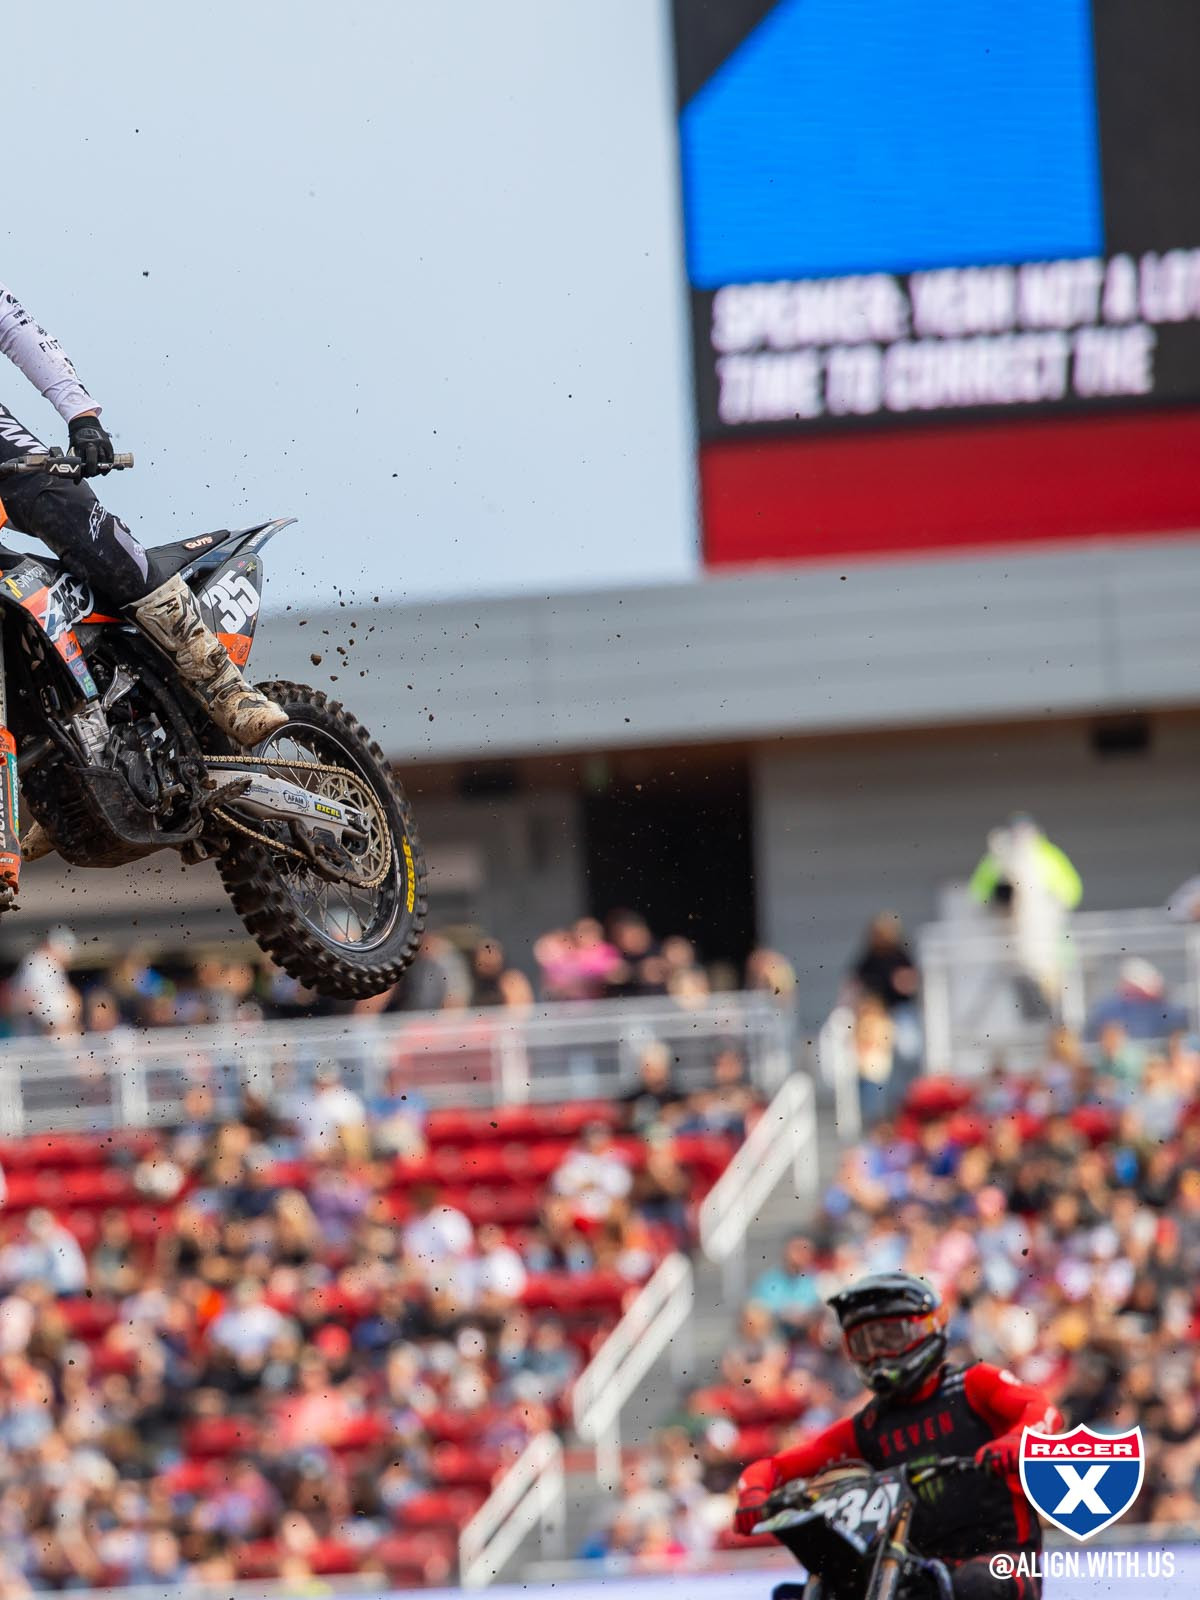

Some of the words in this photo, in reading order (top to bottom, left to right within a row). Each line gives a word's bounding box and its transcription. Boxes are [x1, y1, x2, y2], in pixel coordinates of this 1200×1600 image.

[1103, 253, 1136, 322] A
[49, 463, 80, 474] ASV
[201, 570, 261, 635] 35
[316, 804, 341, 817] EXCEL
[879, 1410, 954, 1457] SEVEN
